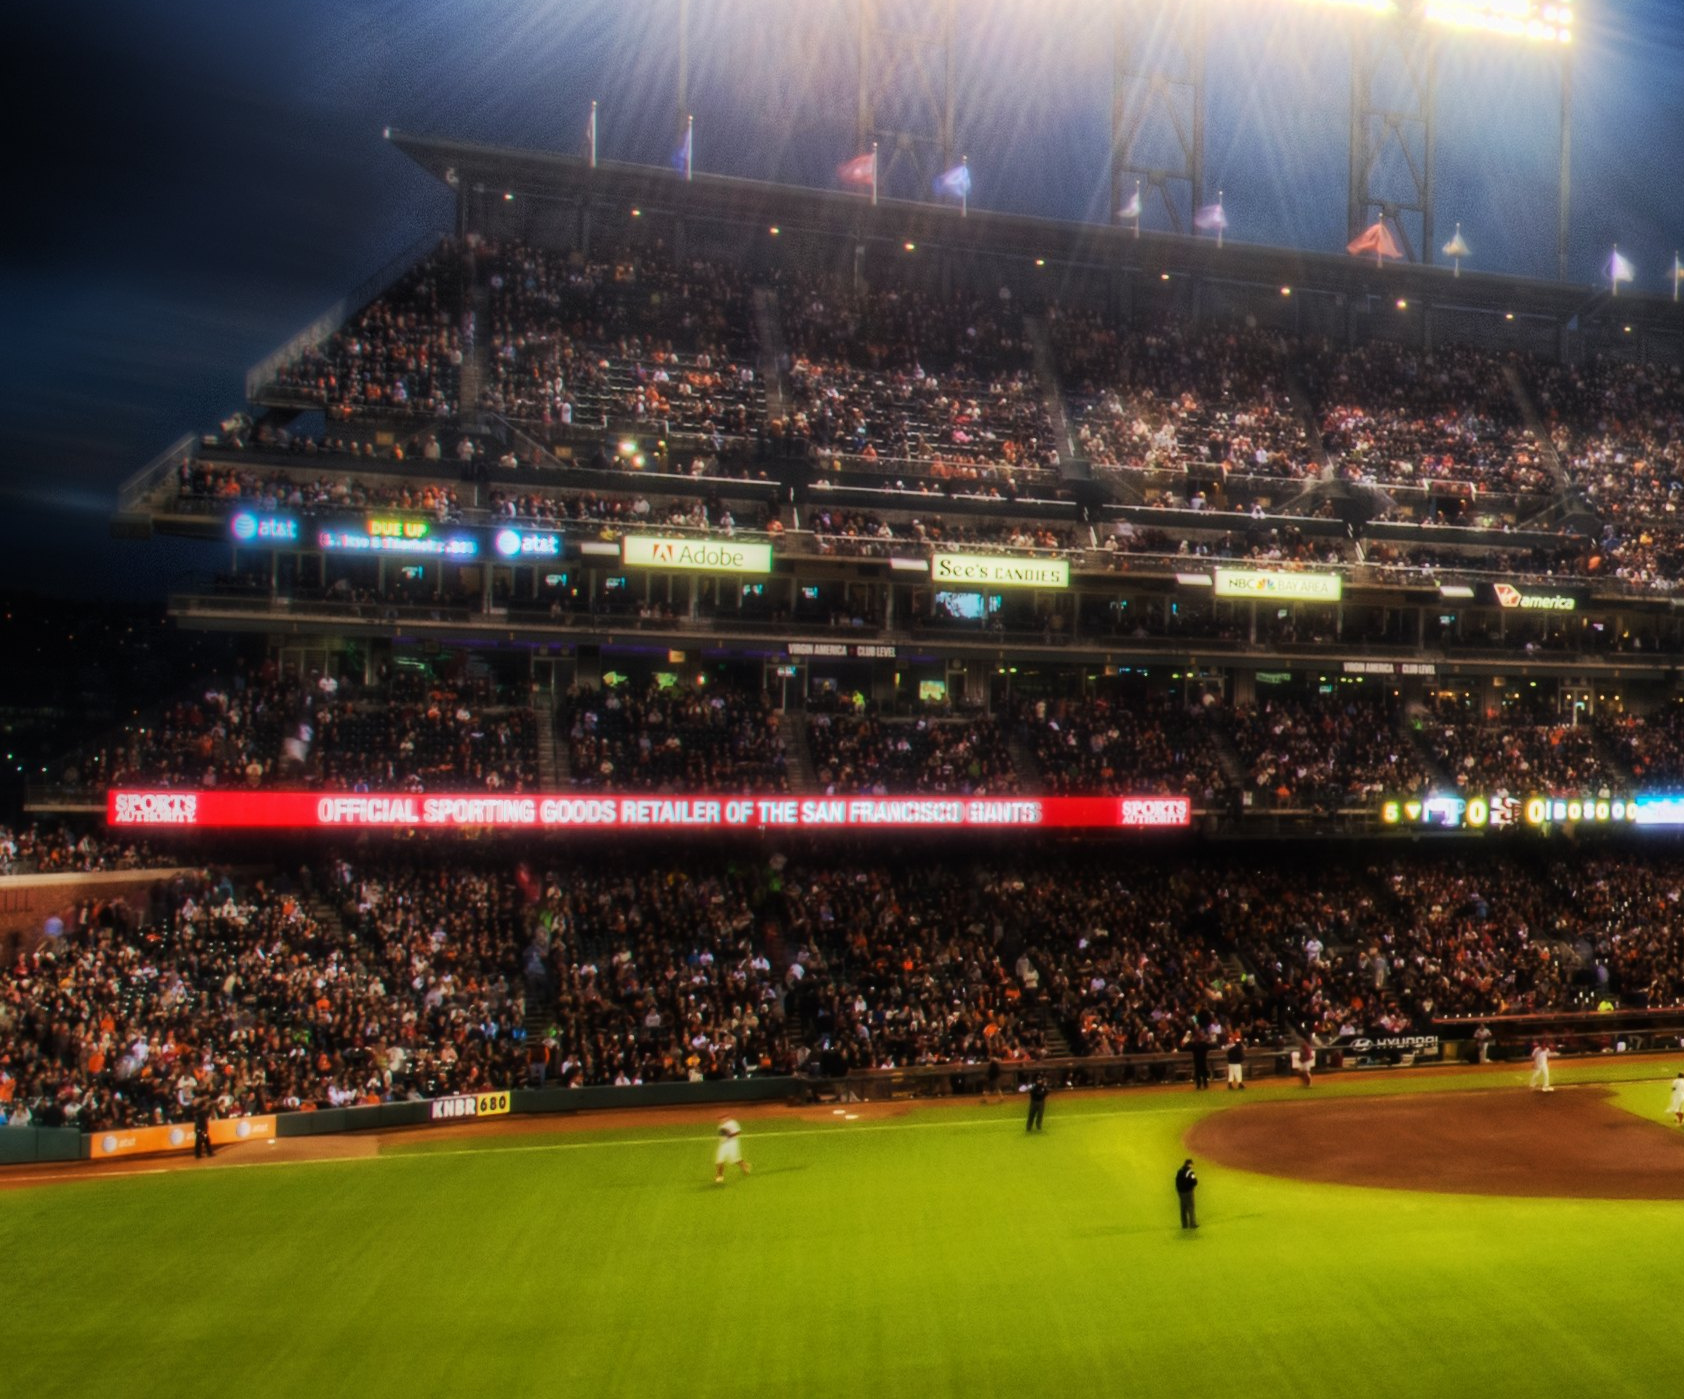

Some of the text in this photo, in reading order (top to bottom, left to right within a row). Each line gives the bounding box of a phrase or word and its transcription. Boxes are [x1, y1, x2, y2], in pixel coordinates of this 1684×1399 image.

[258, 519, 297, 540] at&t
[370, 520, 428, 537] DUE UP
[520, 535, 558, 554] at&t
[679, 545, 744, 566] Adobe
[940, 559, 1060, 583] See's CANDIES
[1228, 578, 1329, 593] NBC BAY AREA
[1520, 595, 1575, 610] america
[788, 643, 896, 658] VIRGIN AMERICA CLUB LEVEL
[115, 794, 197, 812] SPORTS
[317, 799, 1041, 824] OFFICIAL SPORTING GOODS RETAILER OF THE SAN FRANCISCO GIANTS
[1121, 800, 1187, 814] SPORTS
[115, 811, 197, 823] AUTHORITY
[1121, 814, 1187, 825] AUTHORITY
[1377, 1035, 1439, 1048] HYUNDAI
[432, 1095, 507, 1119] KNBR 680
